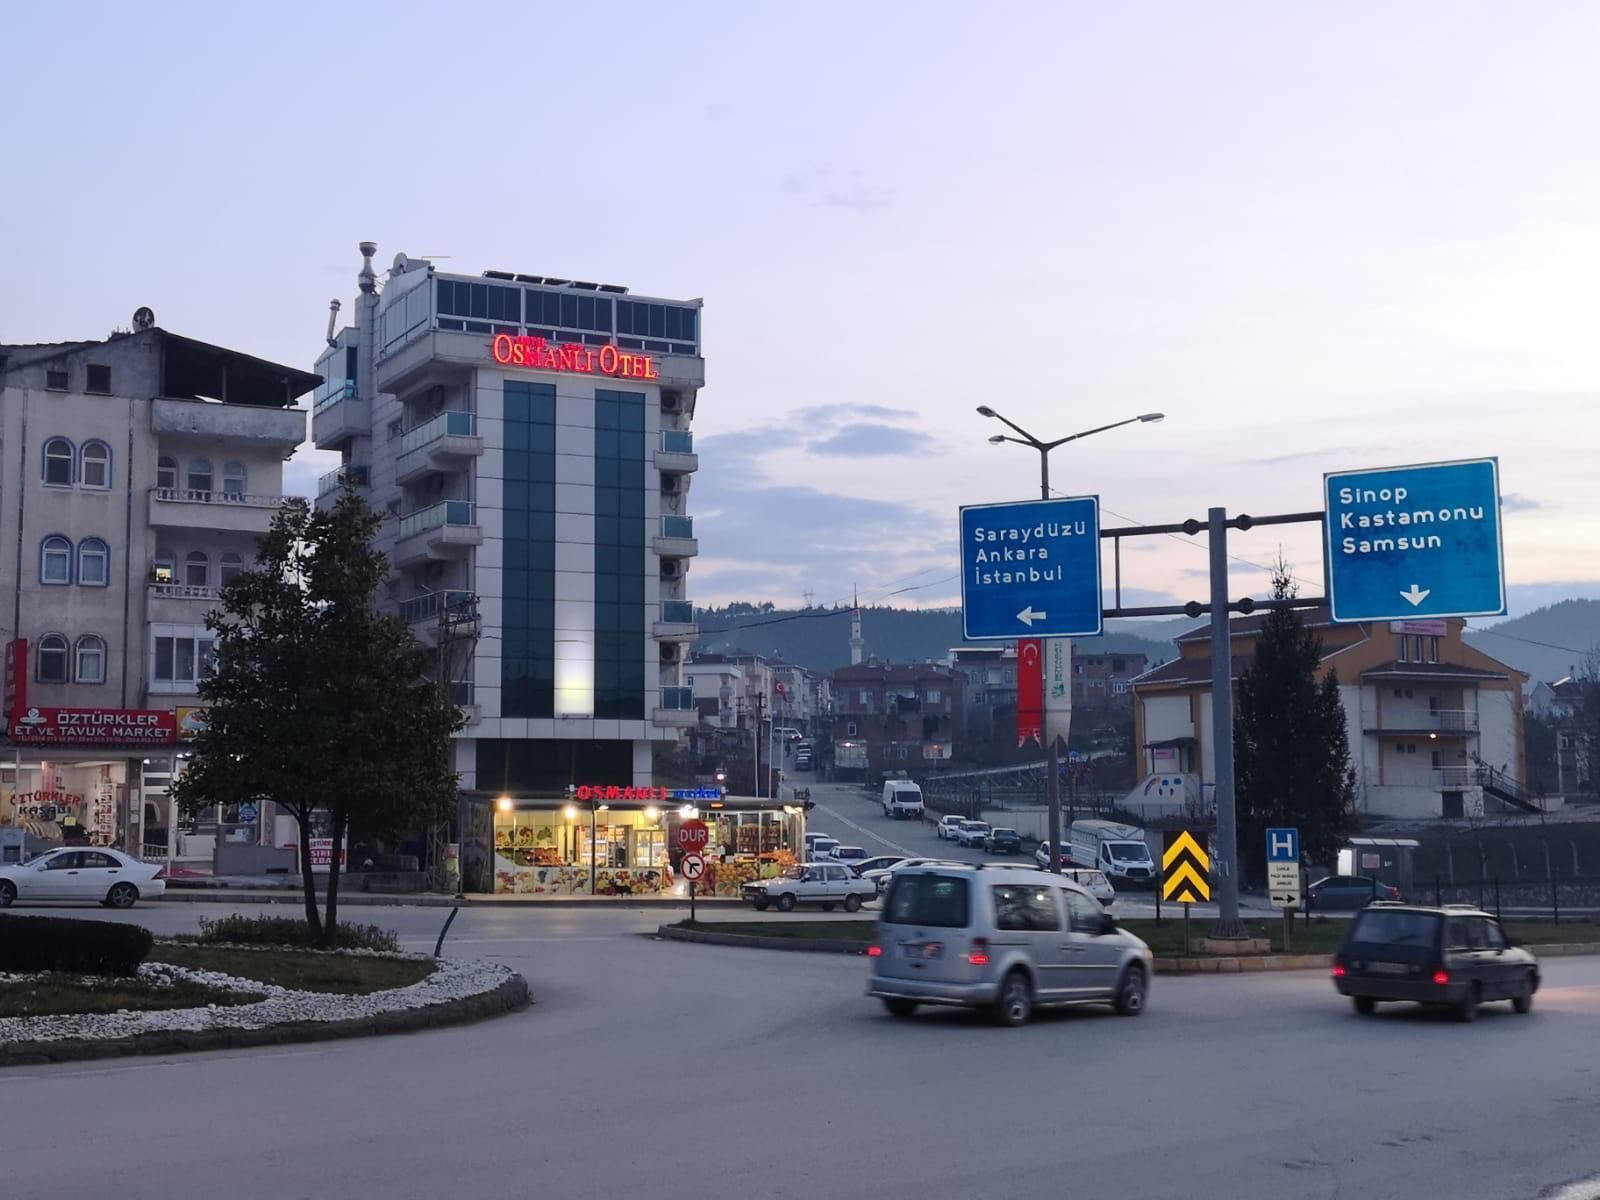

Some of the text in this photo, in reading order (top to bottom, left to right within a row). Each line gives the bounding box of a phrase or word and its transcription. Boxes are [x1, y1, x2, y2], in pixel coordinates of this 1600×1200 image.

[493, 334, 657, 379] OSMANLI OTEL
[1339, 487, 1408, 505] Sinop
[1340, 506, 1484, 529] Kastamonu
[1342, 535, 1441, 554] Samsun
[975, 546, 1049, 563] Ankara
[975, 565, 1062, 585] İstanbul
[57, 710, 159, 725] ÖZTÜRKLER
[15, 726, 172, 737] ET VE TAVUK MARKET
[577, 785, 667, 800] OSMANLI
[680, 829, 707, 843] DUR
[1272, 832, 1293, 857] H
